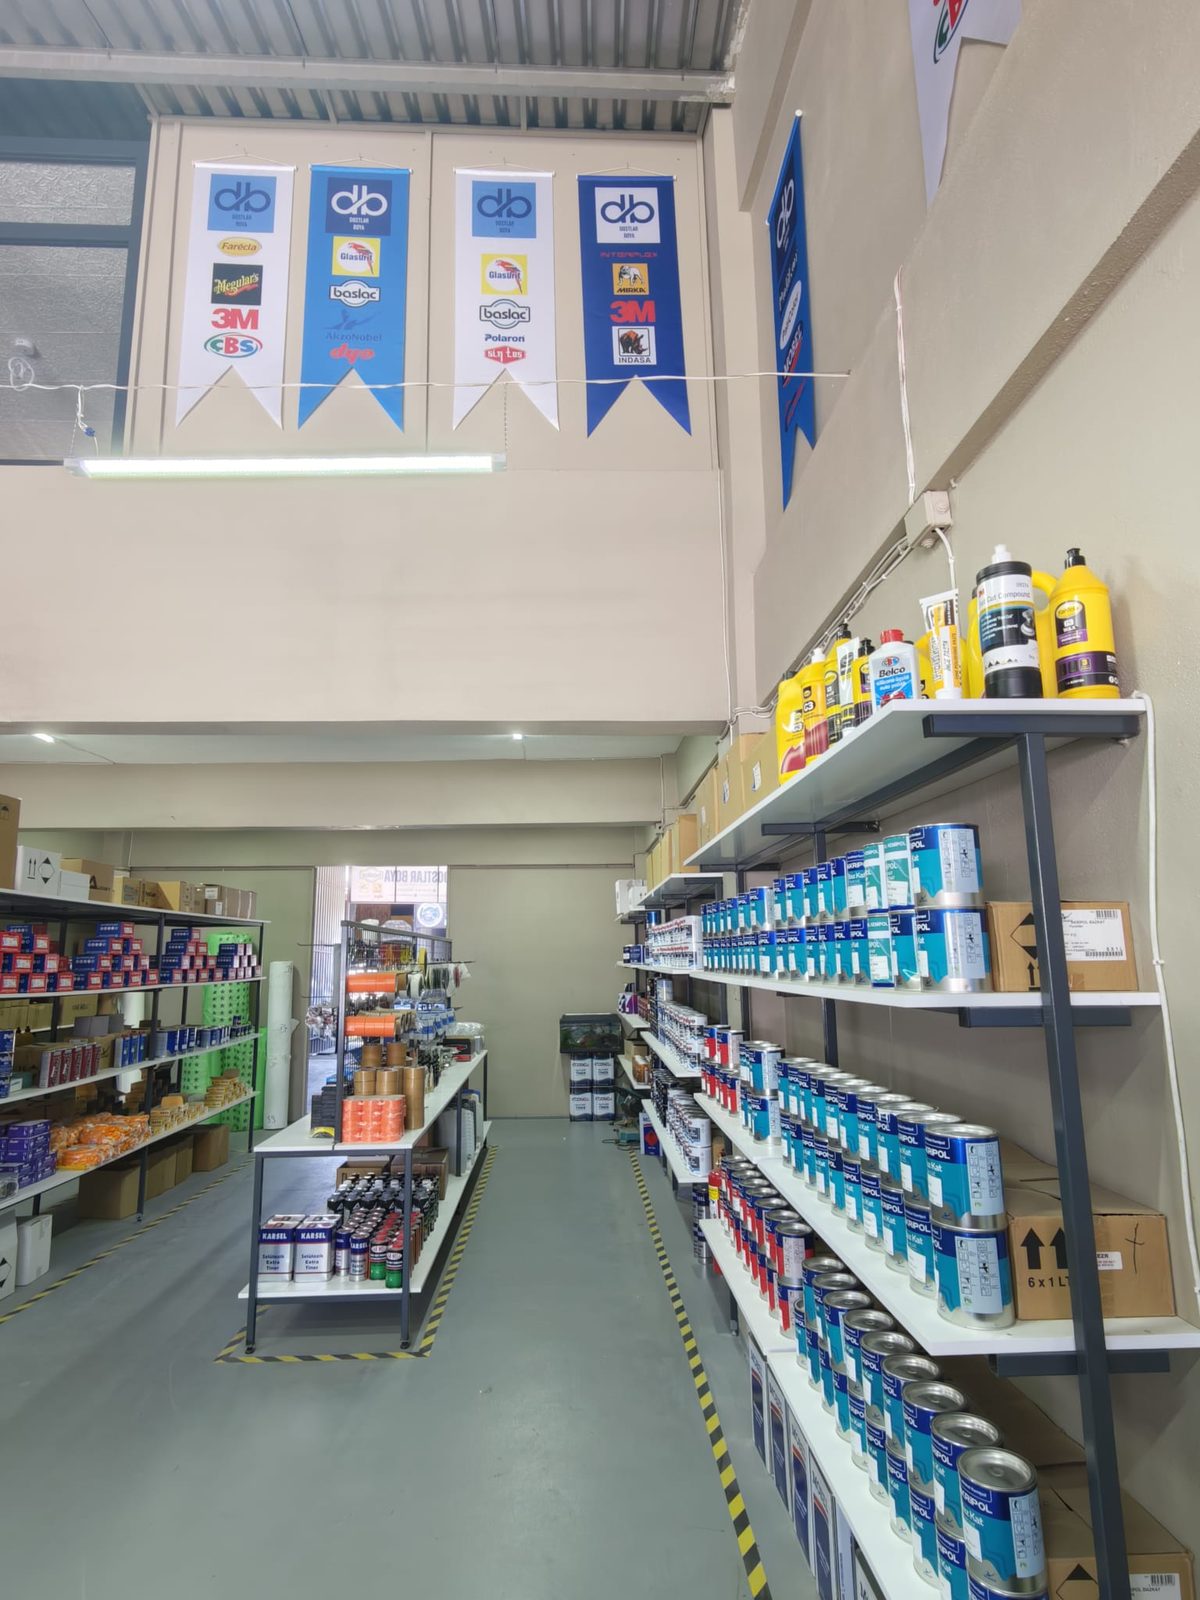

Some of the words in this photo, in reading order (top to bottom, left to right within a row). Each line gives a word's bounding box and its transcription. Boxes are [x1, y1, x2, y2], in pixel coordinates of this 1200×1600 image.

[333, 287, 377, 300] baslac
[483, 308, 526, 320] baslac
[610, 301, 656, 323] 3M
[211, 308, 259, 330] 3M
[484, 334, 526, 343] Polaron
[209, 336, 255, 354] CBS
[618, 356, 651, 364] INDASA
[879, 667, 905, 678] Belco
[262, 1232, 288, 1240] KARSEL
[301, 1232, 326, 1240] KARSEL
[1028, 1276, 1036, 1288] 6
[1038, 1279, 1046, 1288] x
[1049, 1276, 1054, 1288] 1
